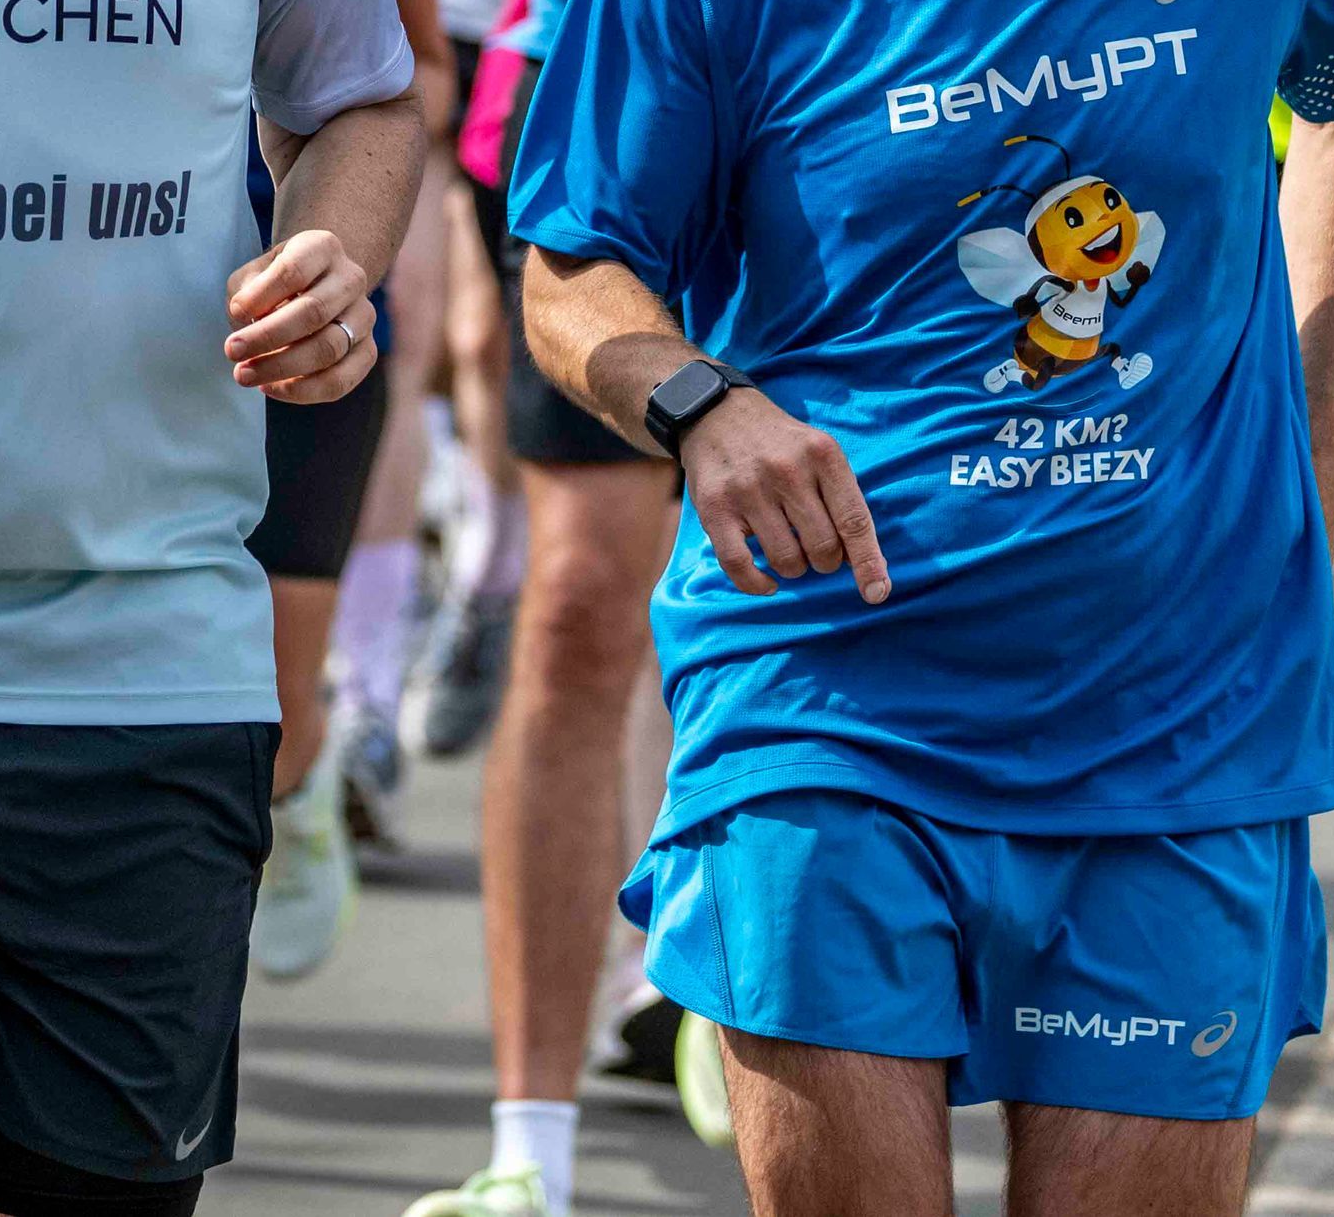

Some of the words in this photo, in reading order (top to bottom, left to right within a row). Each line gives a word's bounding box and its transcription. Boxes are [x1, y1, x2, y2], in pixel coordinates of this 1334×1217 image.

[885, 27, 1198, 134] BeMyPT
[88, 169, 192, 241] uns!
[1052, 302, 1102, 326] Beemi
[994, 417, 1045, 449] 42
[1054, 413, 1129, 448] KM?
[949, 453, 1046, 489] EASY
[1049, 447, 1156, 487] BEEZY
[1015, 1006, 1186, 1047] BeMyPT
